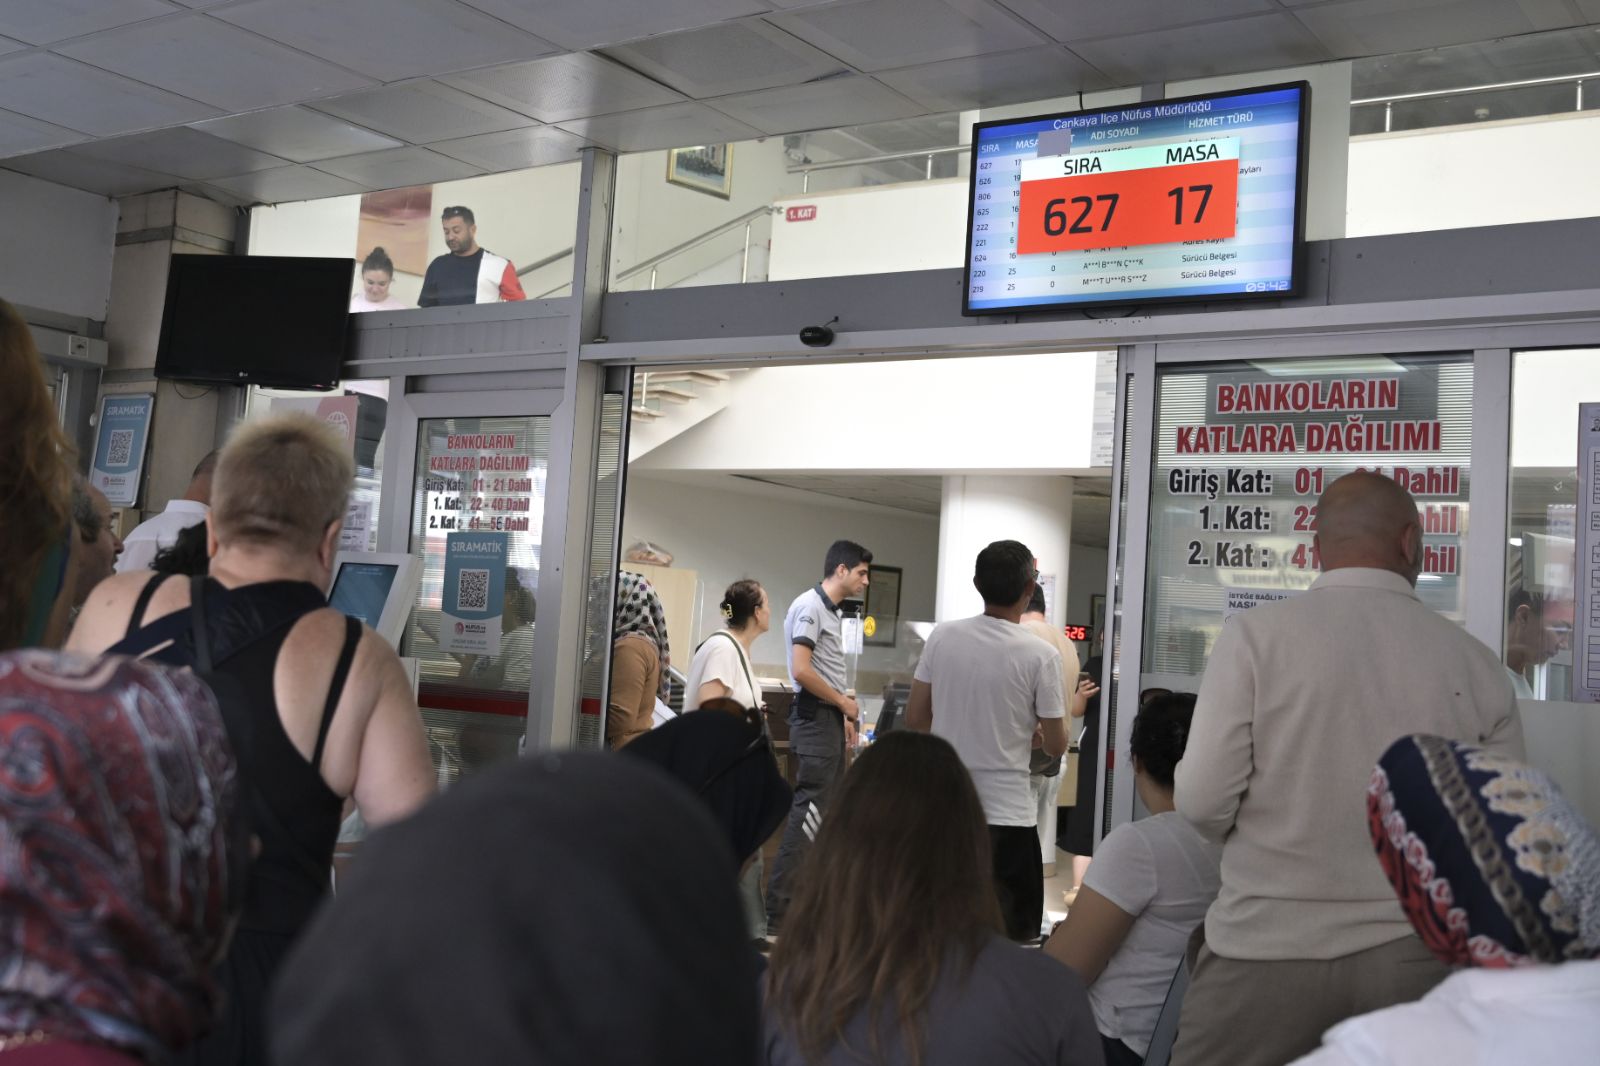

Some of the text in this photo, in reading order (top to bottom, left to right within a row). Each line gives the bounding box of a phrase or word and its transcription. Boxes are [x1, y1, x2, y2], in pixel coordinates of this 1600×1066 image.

[1121, 107, 1152, 121] Nüfus
[1188, 111, 1253, 129] HİZMET TÜRÜ
[1090, 126, 1139, 140] ADI SOYADI
[981, 144, 1000, 153] SIRA
[980, 162, 992, 170] 627
[1064, 143, 1220, 175] SIRA MASA
[978, 174, 1021, 186] 626 19
[797, 208, 813, 218] KAT
[976, 208, 990, 216] 625
[1043, 193, 1120, 236] 627
[1167, 184, 1213, 225] 17
[975, 239, 987, 247] 221
[973, 270, 986, 278] 220
[1007, 267, 1016, 275] 25
[1181, 254, 1208, 262] Sürücü
[1209, 251, 1237, 261] Belgesi
[1007, 283, 1016, 291] 25
[1180, 270, 1207, 279] Sürücü
[1208, 269, 1237, 278] Belgesi
[1246, 280, 1288, 292] 09:42
[1217, 379, 1398, 412] BANKOLARIN
[447, 434, 515, 449] BANKOLARIN
[1176, 415, 1441, 453] KATLARA DAĞILIMI
[430, 453, 529, 471] KATLARA DAĞILIMI
[425, 478, 443, 494] Giriş
[447, 478, 464, 491] Kat:
[472, 479, 483, 492] 01
[493, 478, 504, 492] 21
[508, 478, 532, 492] Dahil
[1169, 468, 1219, 500] Giriş
[1226, 468, 1271, 493] Kat:
[1295, 467, 1323, 494] 01
[434, 496, 442, 510] 1.
[445, 496, 462, 510] Kat:
[470, 497, 482, 511] 22
[491, 498, 503, 511] 40
[507, 497, 530, 511] Dahil
[430, 515, 438, 529] 2.
[468, 516, 480, 530] 41
[504, 516, 529, 531] Dahil
[1200, 505, 1218, 530] 1.
[1225, 505, 1270, 530] Kat:
[1419, 506, 1457, 533] hil
[451, 540, 502, 553] SIRAMATİK
[1188, 541, 1208, 565] 2.
[1291, 543, 1320, 569] 41
[1423, 545, 1456, 573] hil
